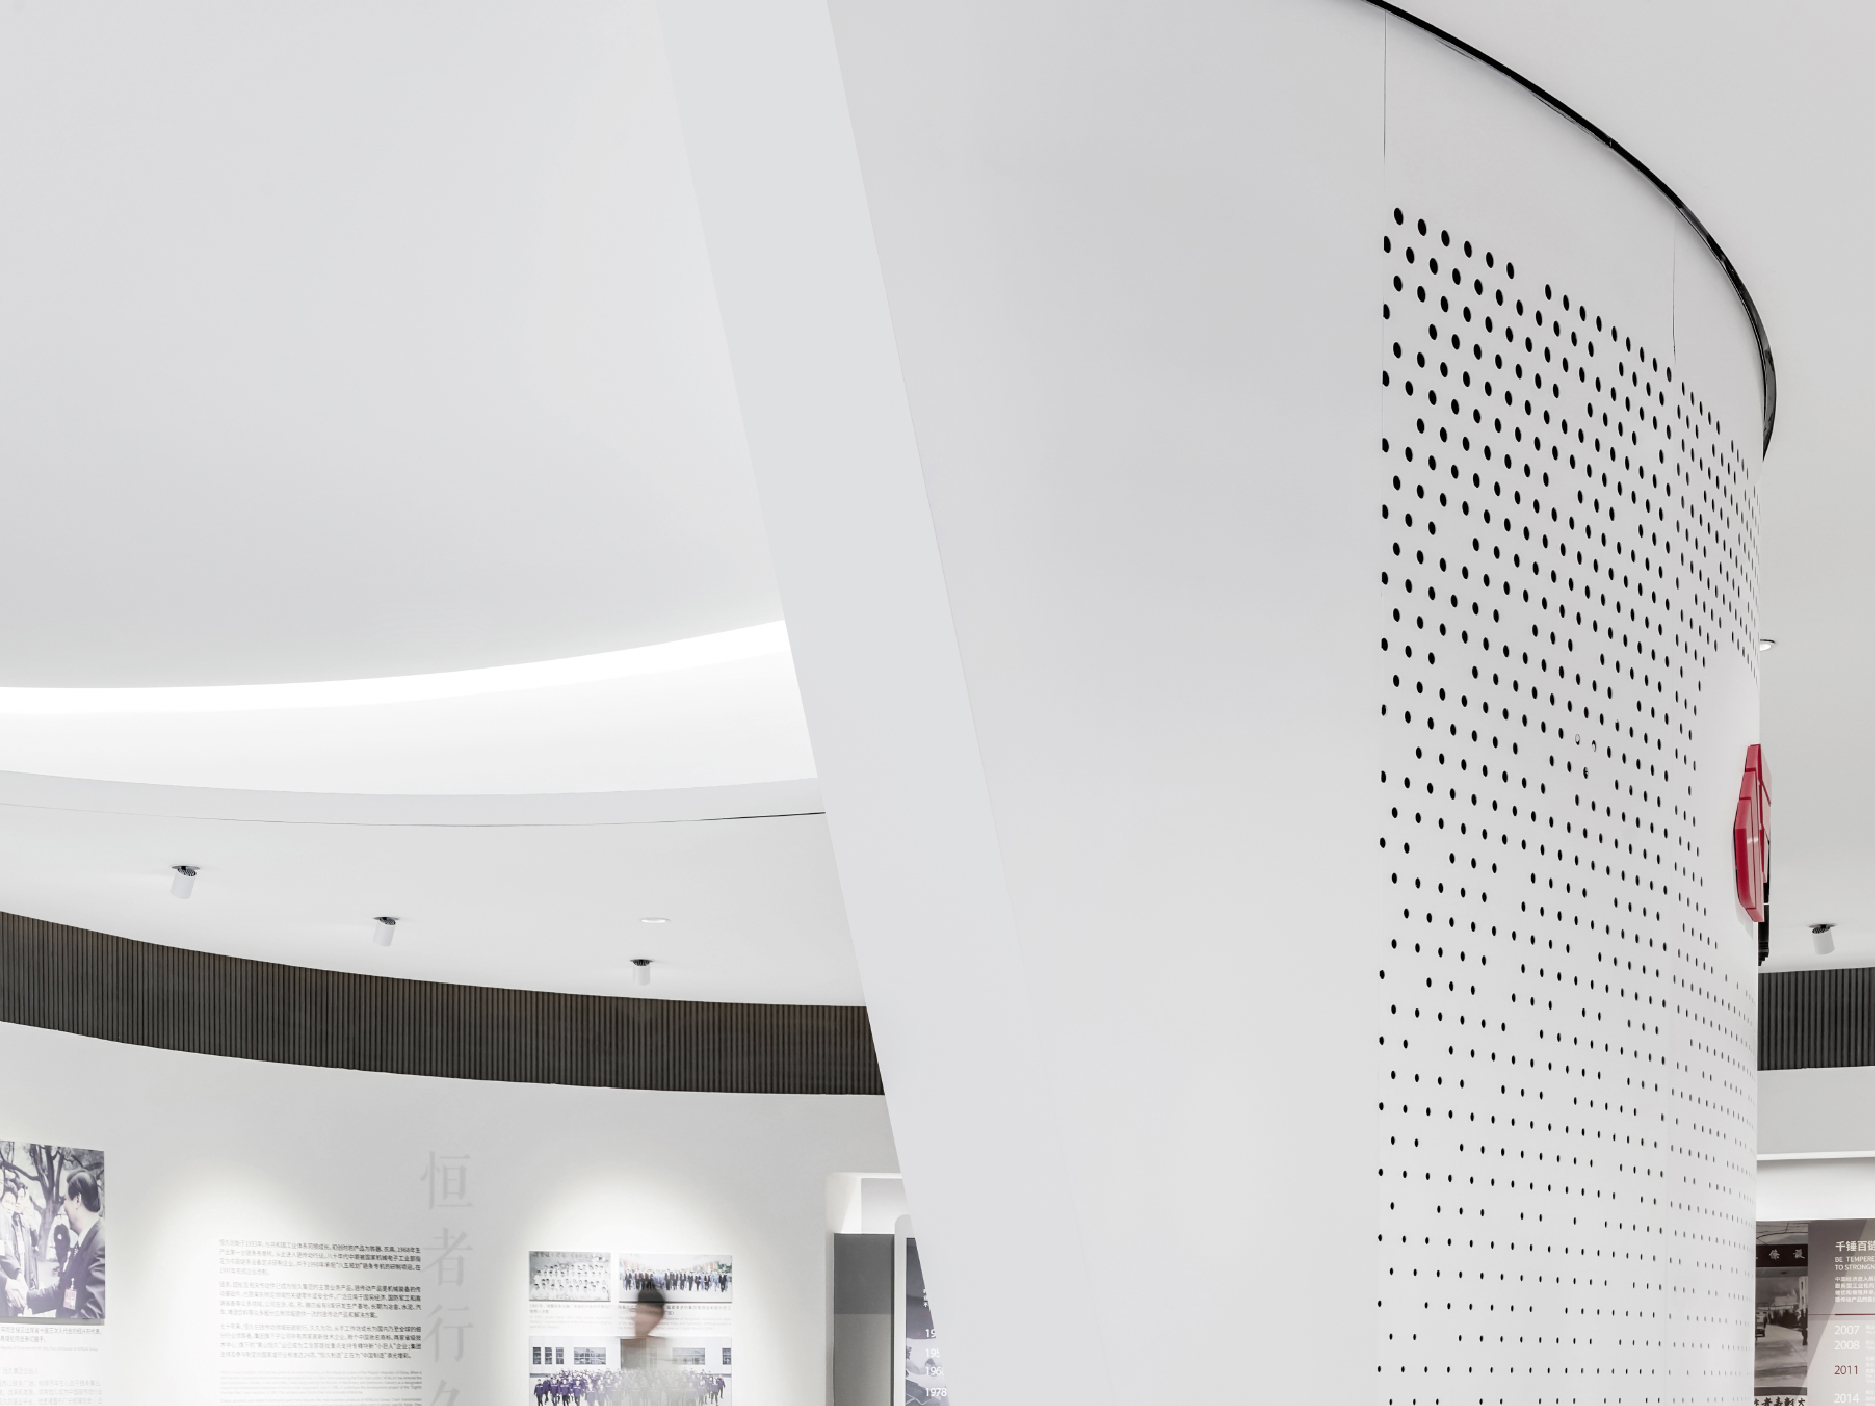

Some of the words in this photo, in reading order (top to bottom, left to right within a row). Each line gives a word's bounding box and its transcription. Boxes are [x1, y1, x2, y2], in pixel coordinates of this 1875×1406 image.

[1834, 1325, 1860, 1335] 2007
[1834, 1340, 1860, 1350] 2008
[1834, 1365, 1858, 1375] 2011
[925, 1387, 947, 1397] 1978
[1834, 1393, 1860, 1404] 2014
